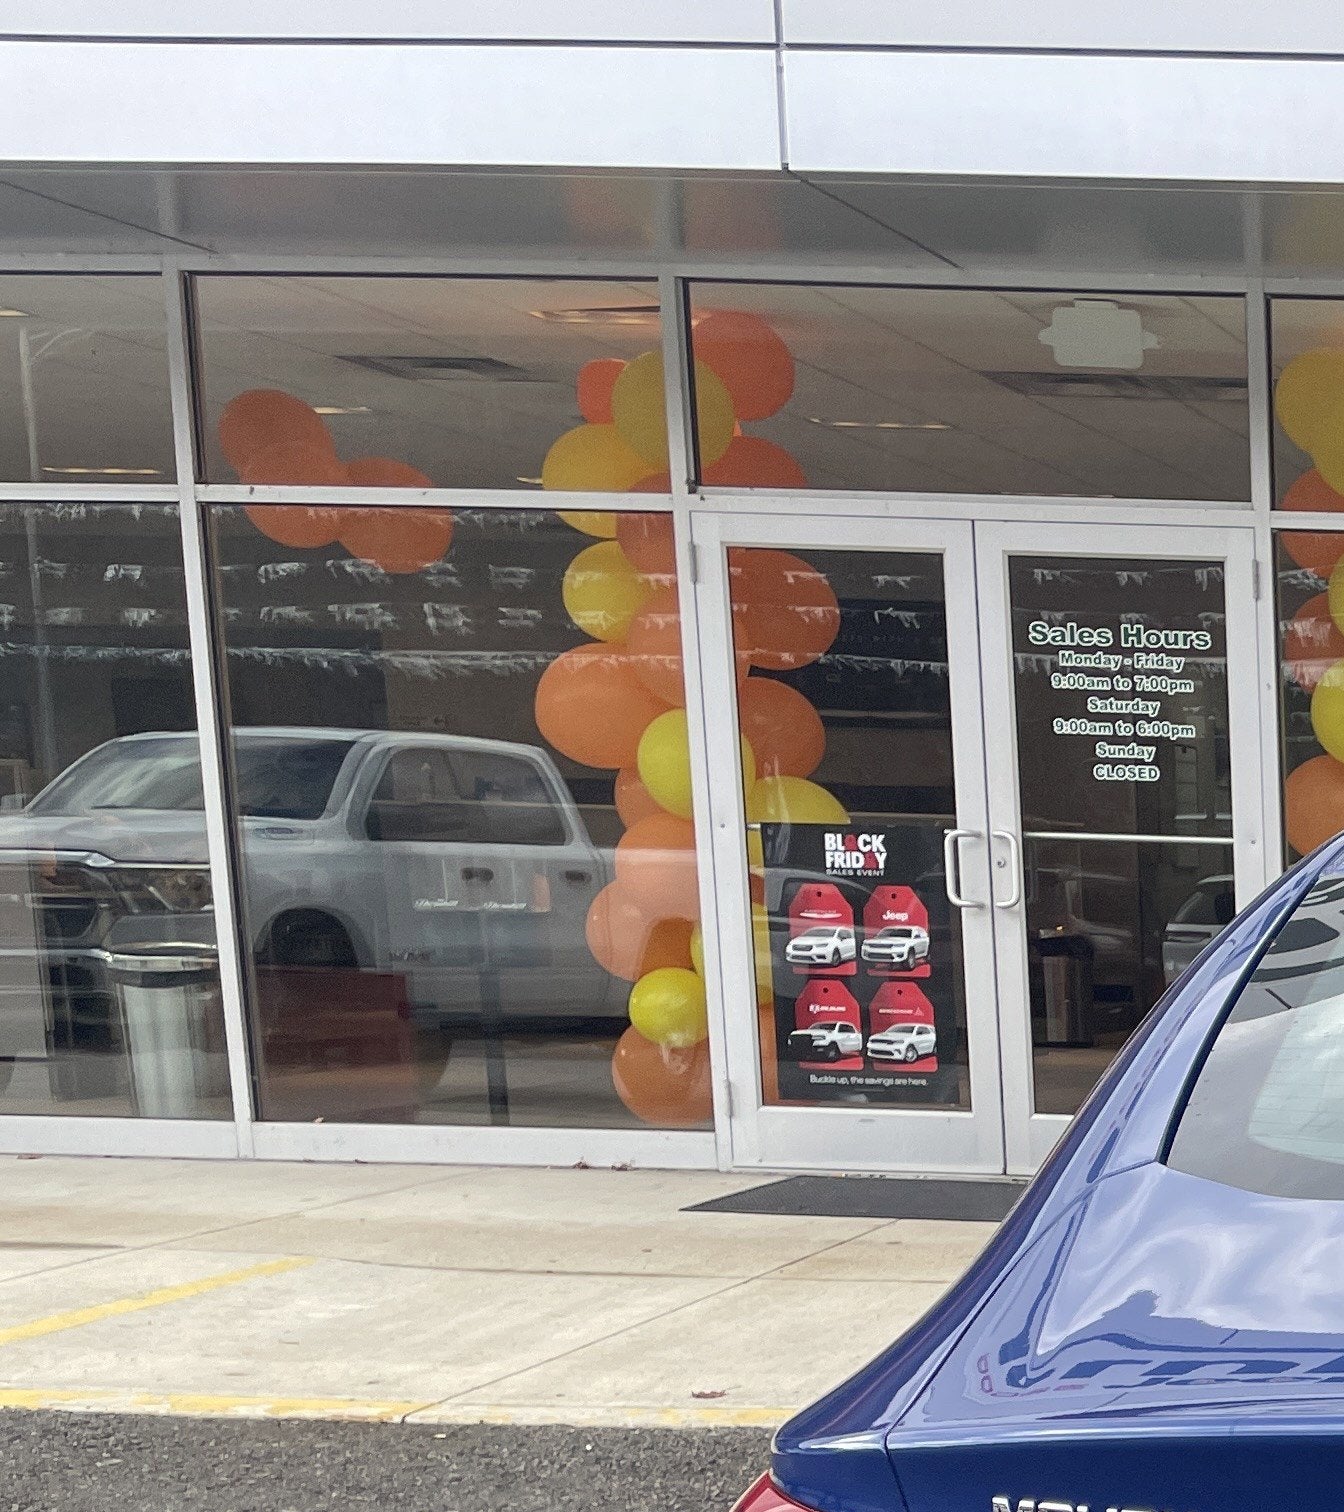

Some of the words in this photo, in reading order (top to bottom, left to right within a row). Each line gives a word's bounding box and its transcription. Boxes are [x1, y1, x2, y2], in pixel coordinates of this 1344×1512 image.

[1028, 621, 1113, 647] Sales
[1120, 624, 1211, 649] Hours
[1059, 650, 1122, 671] Monday
[1133, 652, 1185, 672] Friday
[1051, 673, 1111, 690] 9:00am
[1113, 675, 1132, 690] to
[1134, 675, 1194, 695] 7:00pm
[1087, 696, 1160, 717] Saturday
[1053, 718, 1113, 735] 9:00am
[1115, 720, 1134, 735] to
[1136, 720, 1196, 740] 6:00pm
[1095, 742, 1156, 762] Sunday
[1093, 763, 1160, 781] CLOSED
[882, 909, 909, 922] Jeep
